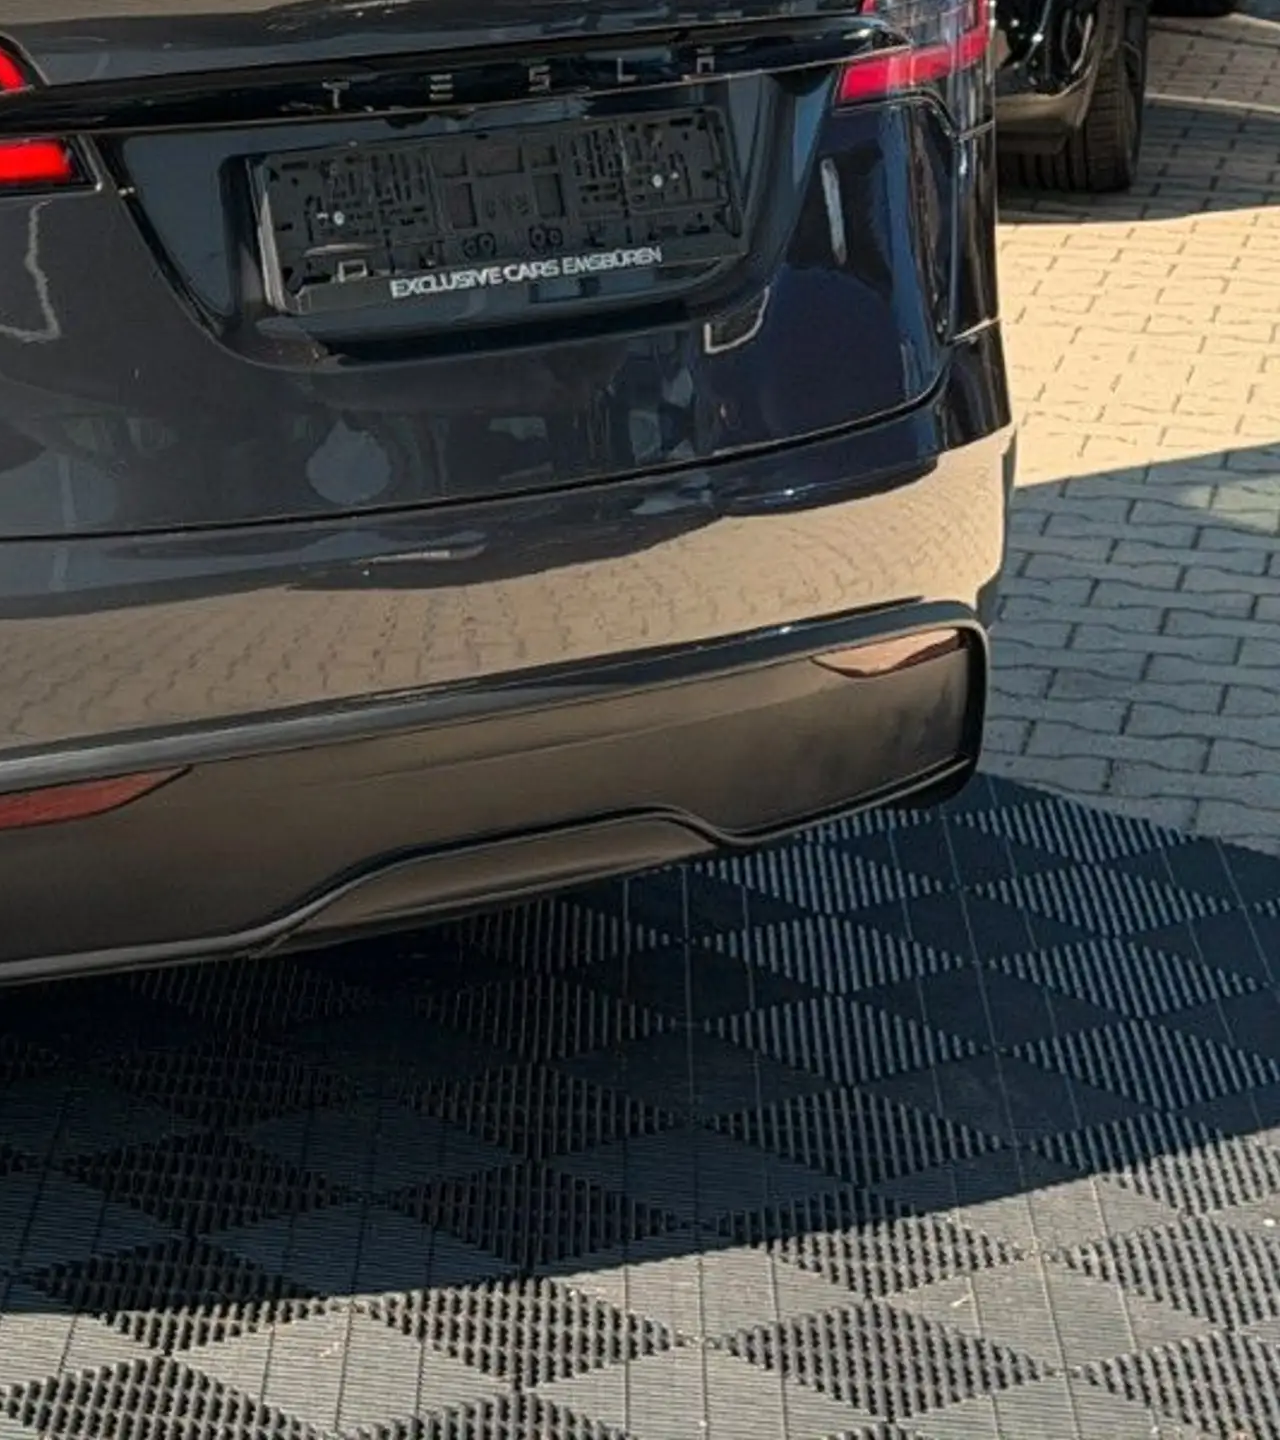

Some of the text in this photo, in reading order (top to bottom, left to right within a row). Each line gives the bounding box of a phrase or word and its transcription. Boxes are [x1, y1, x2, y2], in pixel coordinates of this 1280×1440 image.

[322, 48, 714, 108] TESLA
[390, 267, 502, 299] EXCLUSIVE
[503, 258, 559, 283] CARS
